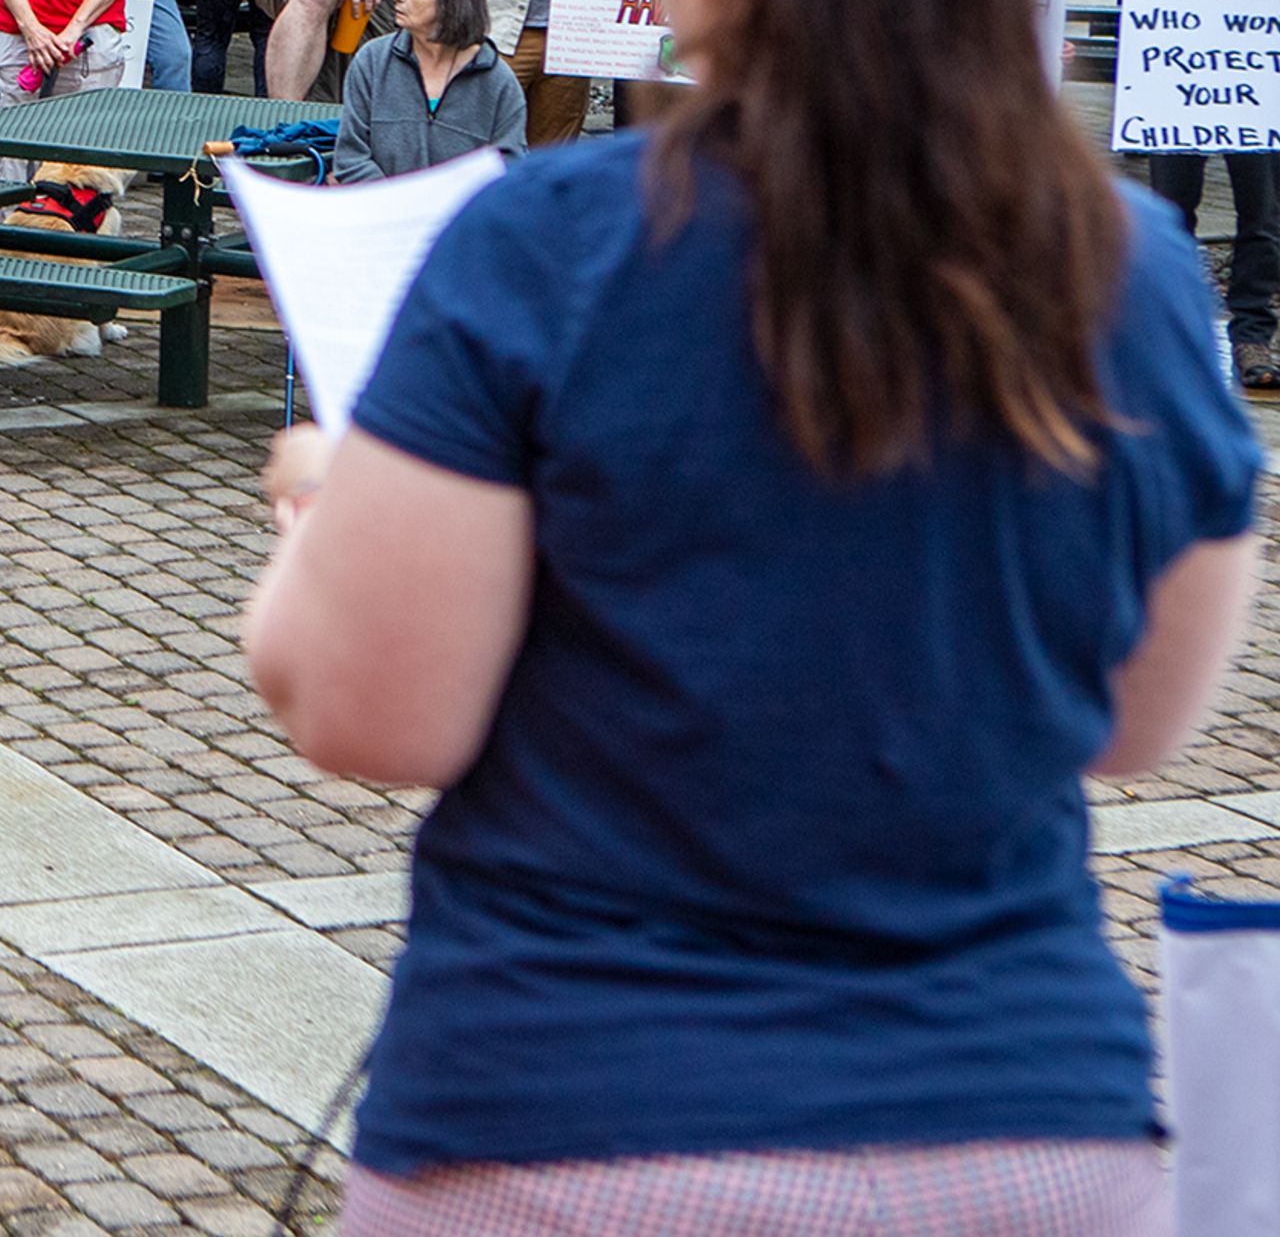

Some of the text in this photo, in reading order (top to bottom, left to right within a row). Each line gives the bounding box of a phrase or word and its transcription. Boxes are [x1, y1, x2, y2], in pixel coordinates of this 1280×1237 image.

[1129, 7, 1202, 31] WHO
[1142, 46, 1280, 75] PROTECT
[1176, 83, 1260, 106] YOUR
